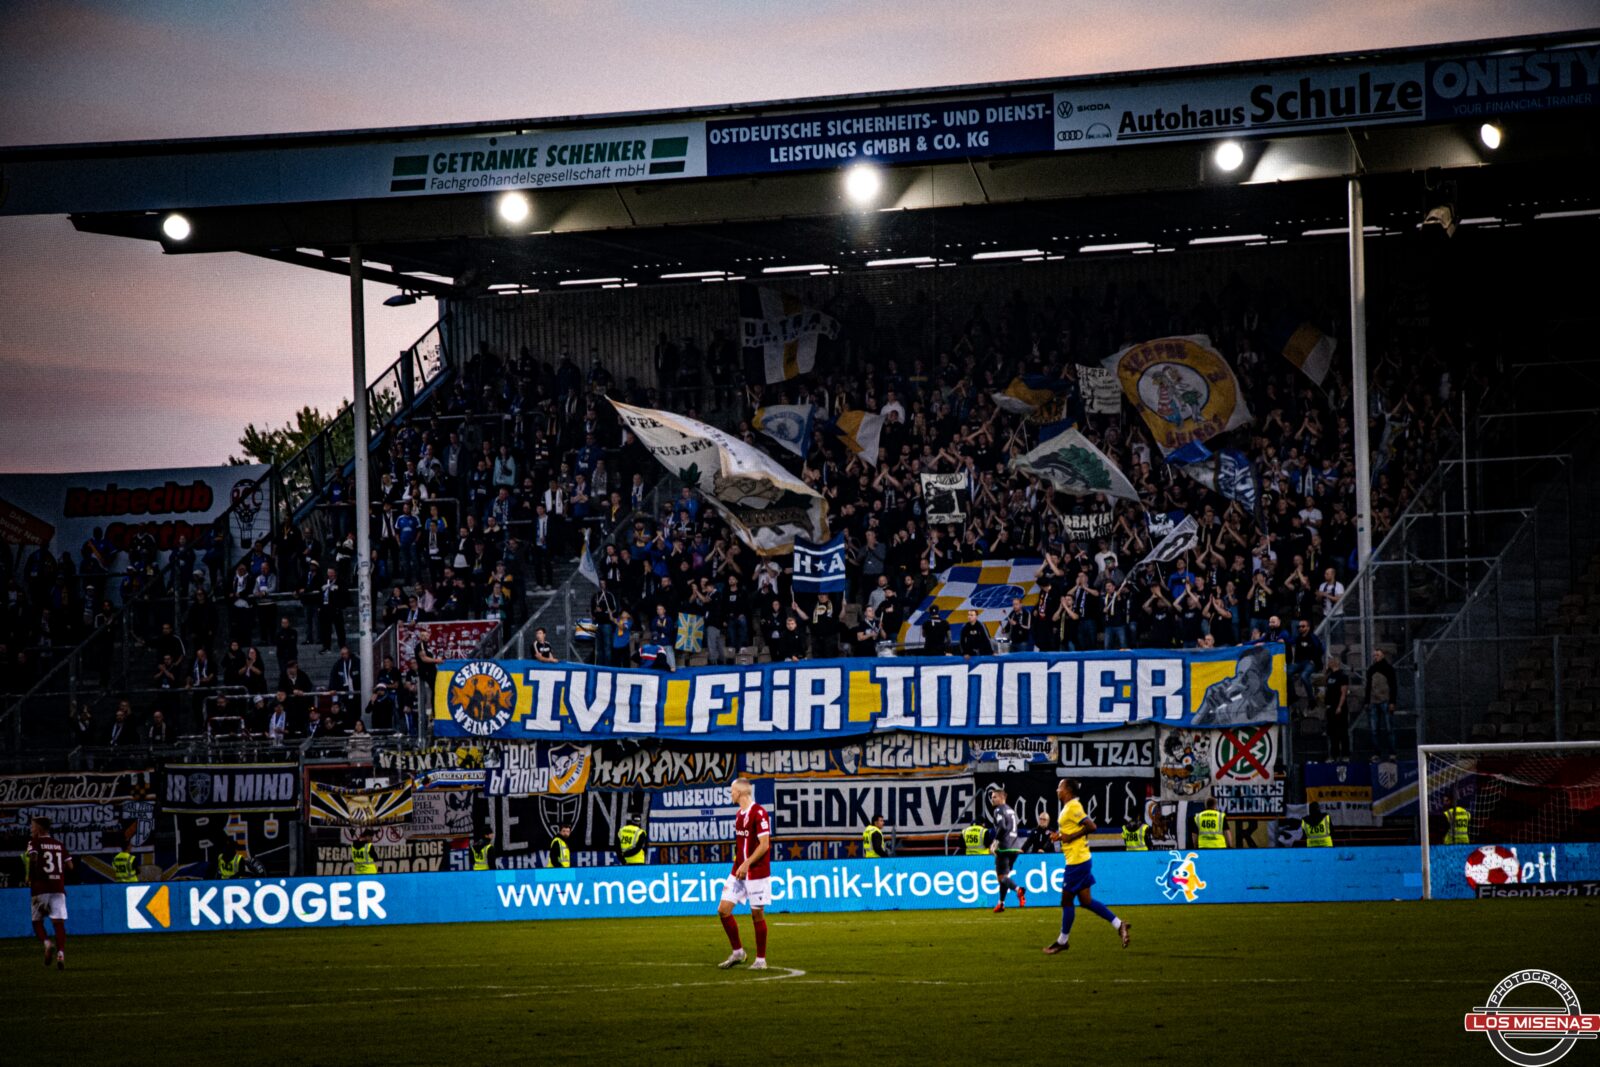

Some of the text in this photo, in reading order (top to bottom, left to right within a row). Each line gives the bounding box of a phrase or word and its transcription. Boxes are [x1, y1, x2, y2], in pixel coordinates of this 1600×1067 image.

[1119, 72, 1424, 133] Autohaus Schulze
[1452, 92, 1593, 115] YOUR FINANCIAL TRAINER
[710, 103, 1052, 144] OSTDEUTSCHE SICHERHEITS- UND DIENST-
[433, 138, 646, 175] GETRÄNKE SCHENKER
[770, 131, 990, 164] LEISTUNGS GMBH & CO. KG
[430, 164, 646, 191] Fachgroßhandelsgesellschaft mbH
[455, 662, 512, 690] SEKTION
[525, 659, 1184, 733] IVO FÜR IMMER
[1061, 741, 1153, 767] ULTRAS
[233, 772, 294, 802] MIND
[776, 783, 974, 829] SÜDKURVE
[42, 851, 63, 875] 31
[415, 840, 444, 857] EDGE
[190, 879, 387, 926] KRÖGER
